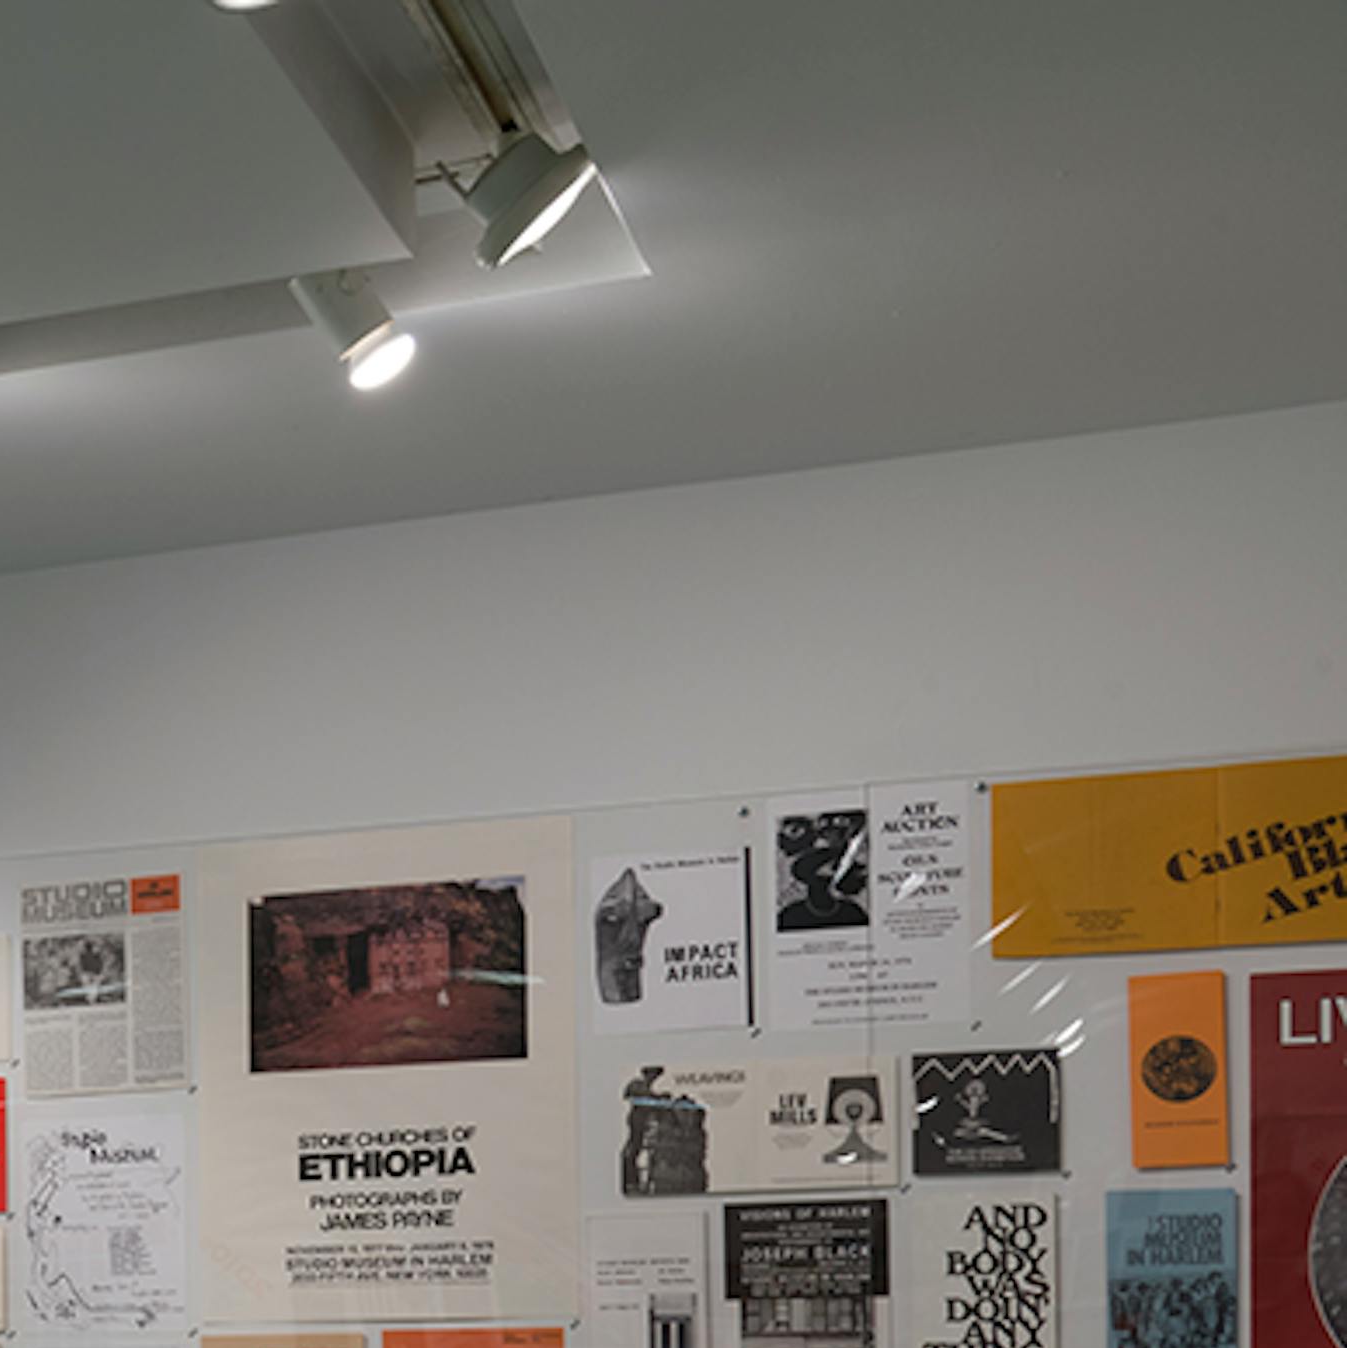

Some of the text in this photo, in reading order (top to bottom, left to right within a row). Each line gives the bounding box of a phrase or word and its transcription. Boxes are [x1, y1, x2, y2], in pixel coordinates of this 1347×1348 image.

[22, 879, 126, 906] STUDIO
[22, 898, 126, 924] MUSEUM
[665, 942, 738, 962] IMPACT
[666, 962, 738, 982] AFRICA
[298, 1125, 477, 1149] STONE CHURCHES OF
[298, 1147, 476, 1181] ETHIOPIA
[309, 1189, 463, 1210] PHOTOGRAPHS BY
[319, 1209, 455, 1232] JAMES PAYNE
[964, 1205, 1048, 1231] AND
[985, 1226, 1037, 1253] NO
[286, 1258, 338, 1271] STUDIO
[342, 1256, 406, 1268] MUSEUM
[428, 1253, 494, 1266] HARLEM
[946, 1248, 1048, 1276] BODY
[963, 1318, 1047, 1348] ANY
